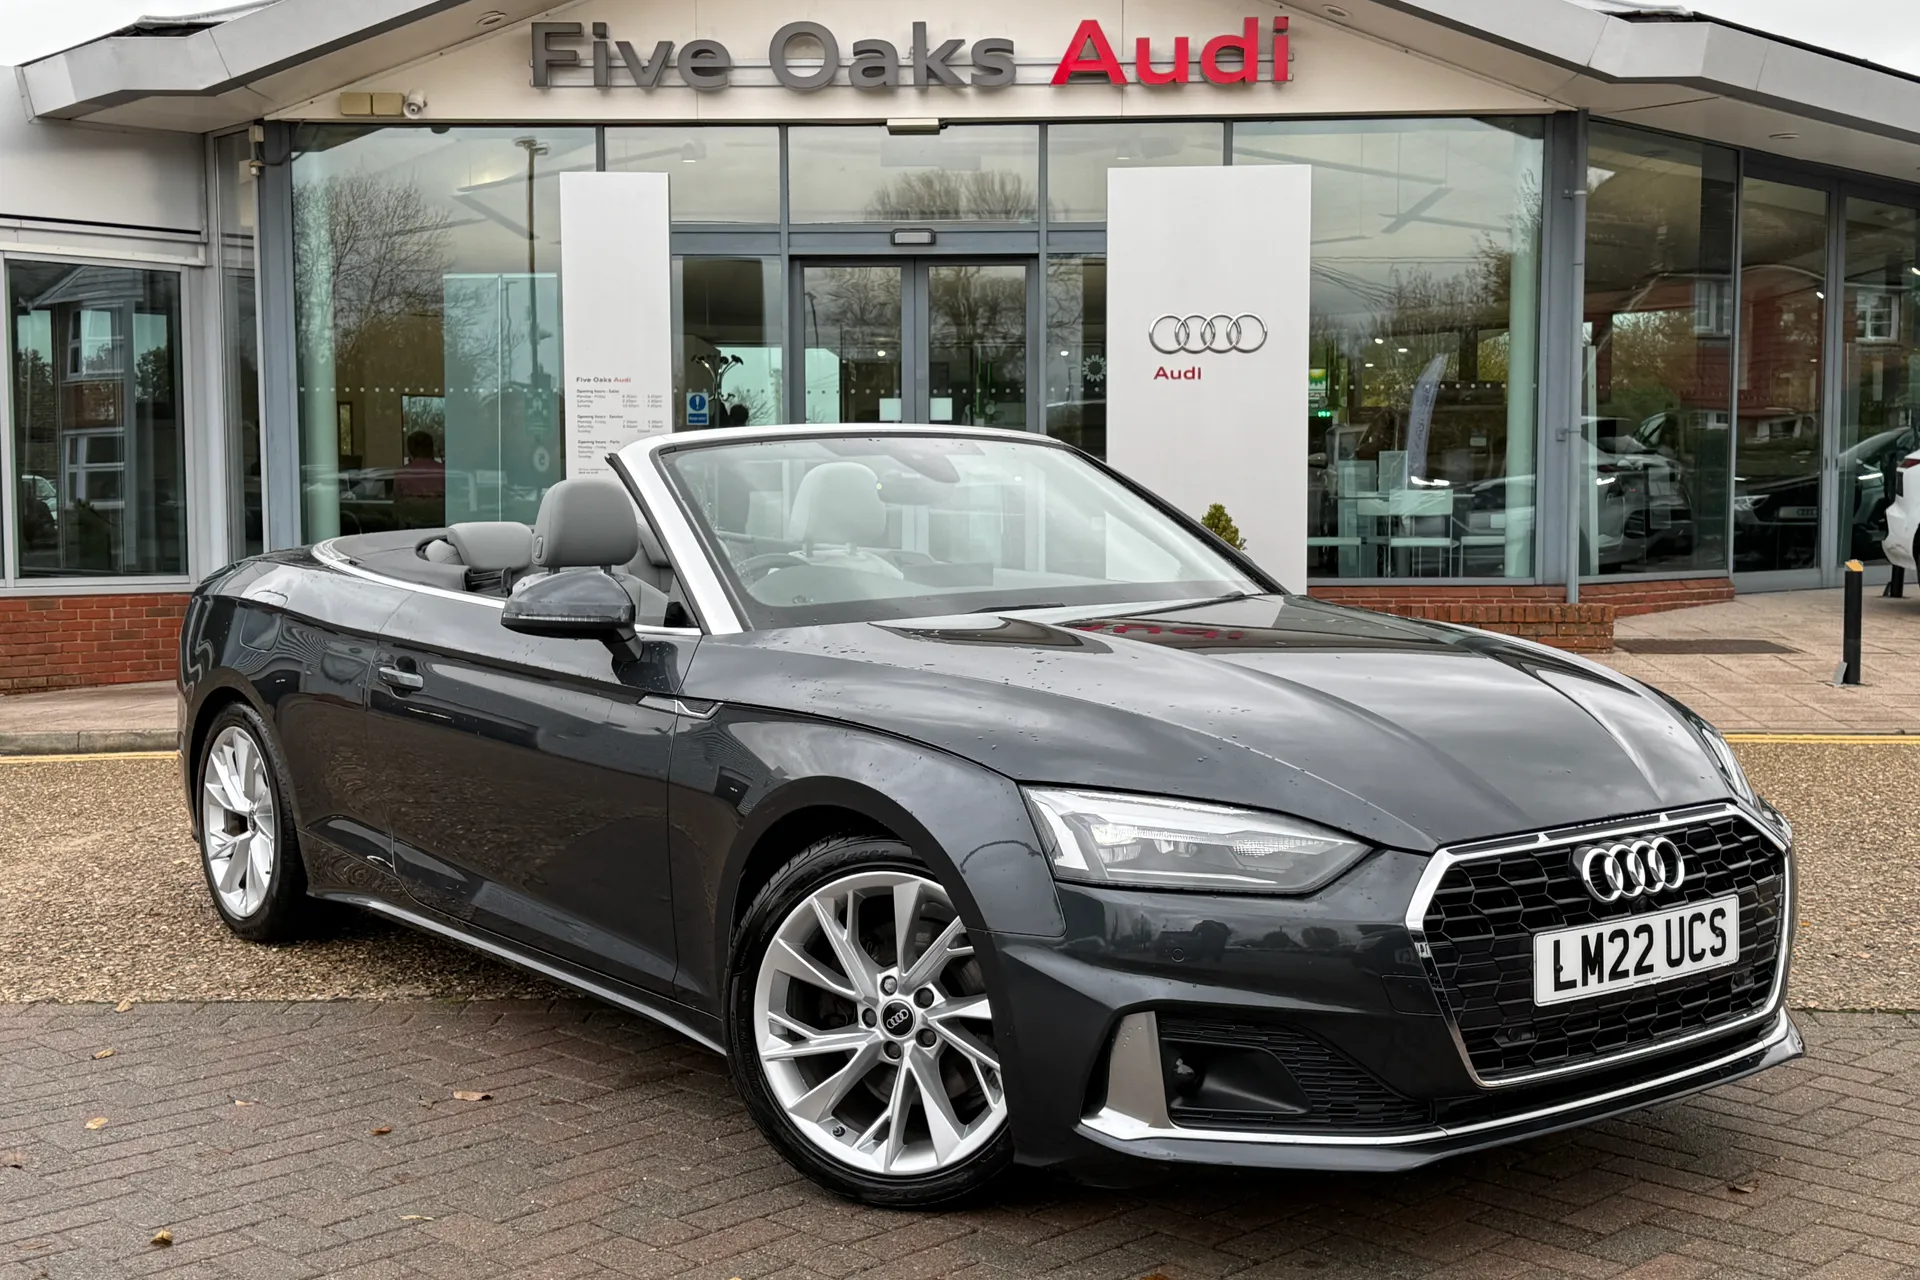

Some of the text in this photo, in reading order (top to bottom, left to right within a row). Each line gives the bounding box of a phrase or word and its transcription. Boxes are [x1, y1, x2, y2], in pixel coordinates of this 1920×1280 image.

[531, 16, 1289, 91] Five Oaks Audi
[1153, 366, 1202, 380] Audi
[1553, 907, 1727, 992] LM22 UCS
